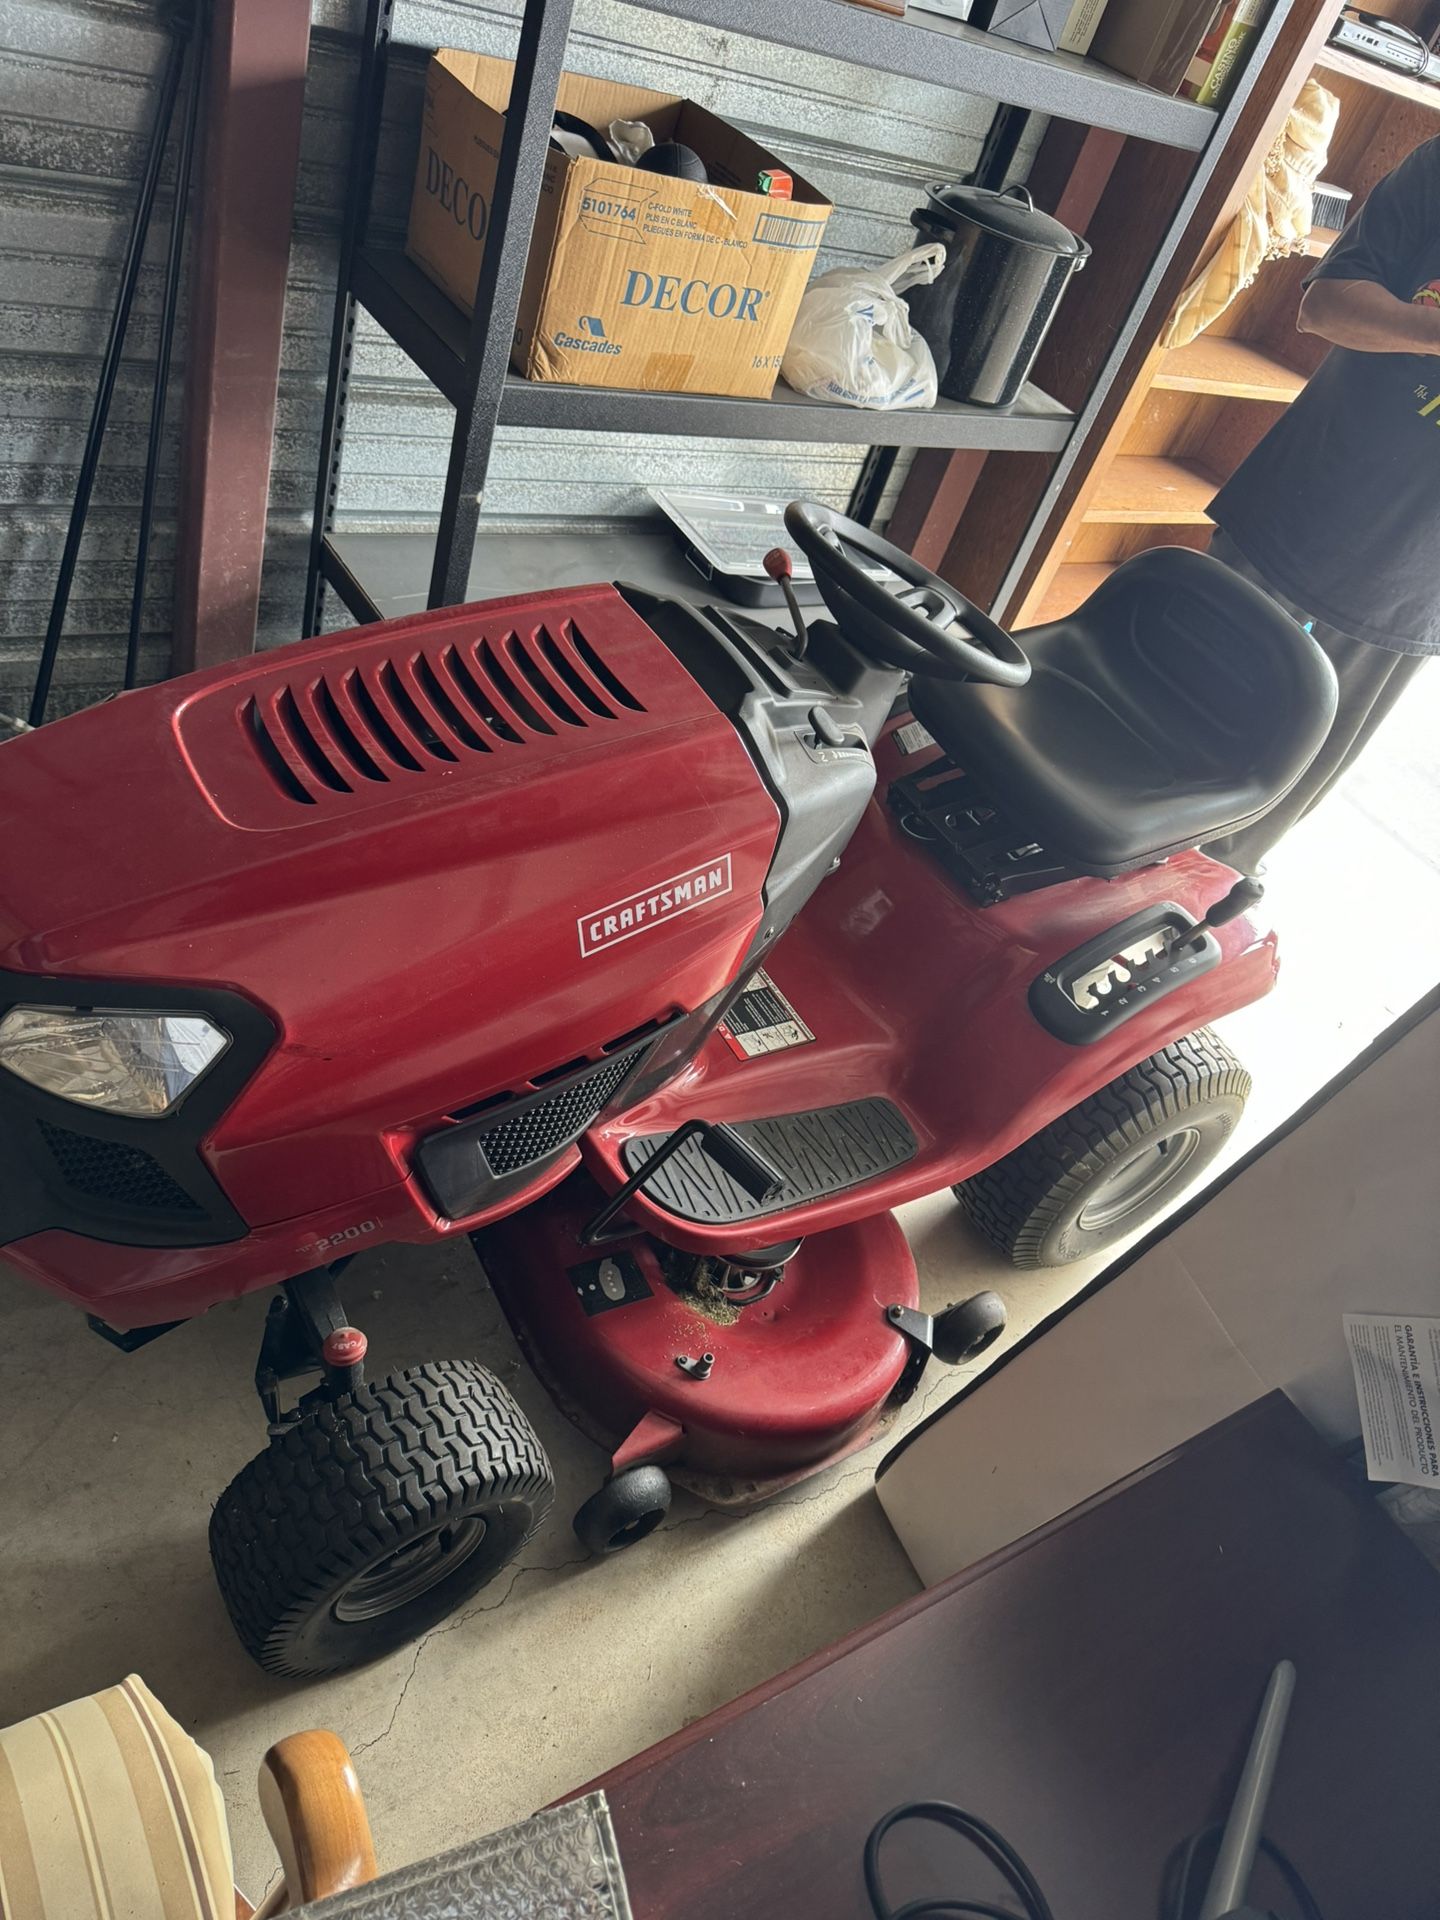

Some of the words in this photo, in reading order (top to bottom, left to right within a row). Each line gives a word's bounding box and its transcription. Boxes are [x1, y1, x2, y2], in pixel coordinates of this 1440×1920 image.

[1210, 38, 1237, 90] CASINO
[426, 147, 487, 240] DECO
[582, 197, 636, 221] 5101764
[645, 213, 660, 223] PLIS
[660, 216, 670, 224] EN
[676, 219, 698, 229] BLANC
[648, 202, 671, 213] C-FOLD
[672, 207, 692, 217] WHITE
[642, 224, 674, 237] PLIEGUES
[674, 229, 682, 237] EN
[684, 231, 704, 241] FORMA
[554, 331, 622, 356] Cascades
[752, 356, 762, 368] 16
[590, 868, 722, 942] CRAFTSMAN
[1394, 1324, 1401, 1333] EL
[1395, 1335, 1416, 1407] MANTENIMIENTO
[1404, 1324, 1418, 1371] GARANTÍA
[1414, 1380, 1434, 1449] INSTRUCCIONES
[1429, 1451, 1439, 1477] PARA
[1411, 1409, 1419, 1424] DEL
[1414, 1427, 1428, 1475] PRODUCTO
